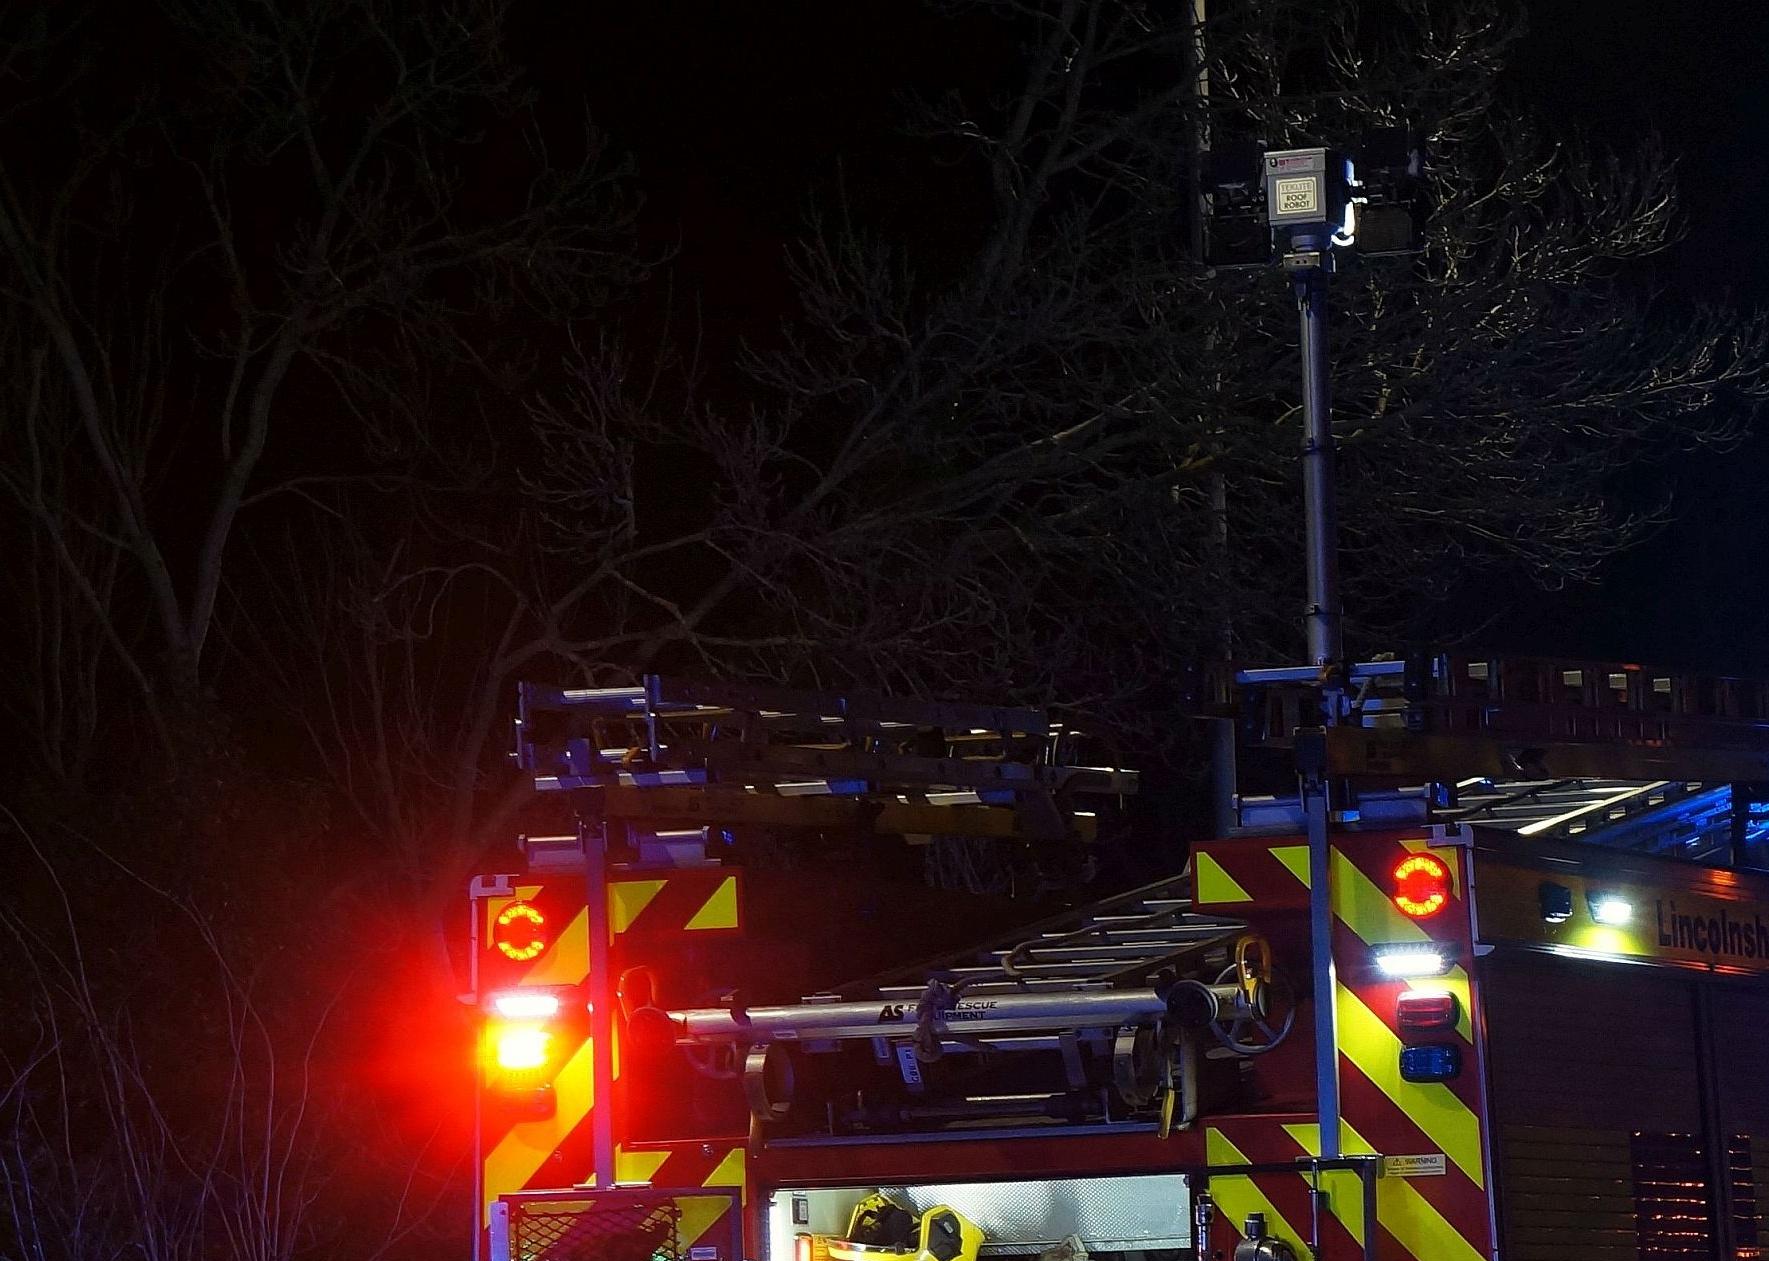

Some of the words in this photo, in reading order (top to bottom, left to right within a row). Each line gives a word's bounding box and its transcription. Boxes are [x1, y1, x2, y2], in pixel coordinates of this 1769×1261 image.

[1286, 193, 1307, 201] ROOF
[1284, 200, 1310, 209] ROBOT
[880, 1005, 904, 1018] AS
[957, 1001, 998, 1010] ESCUE
